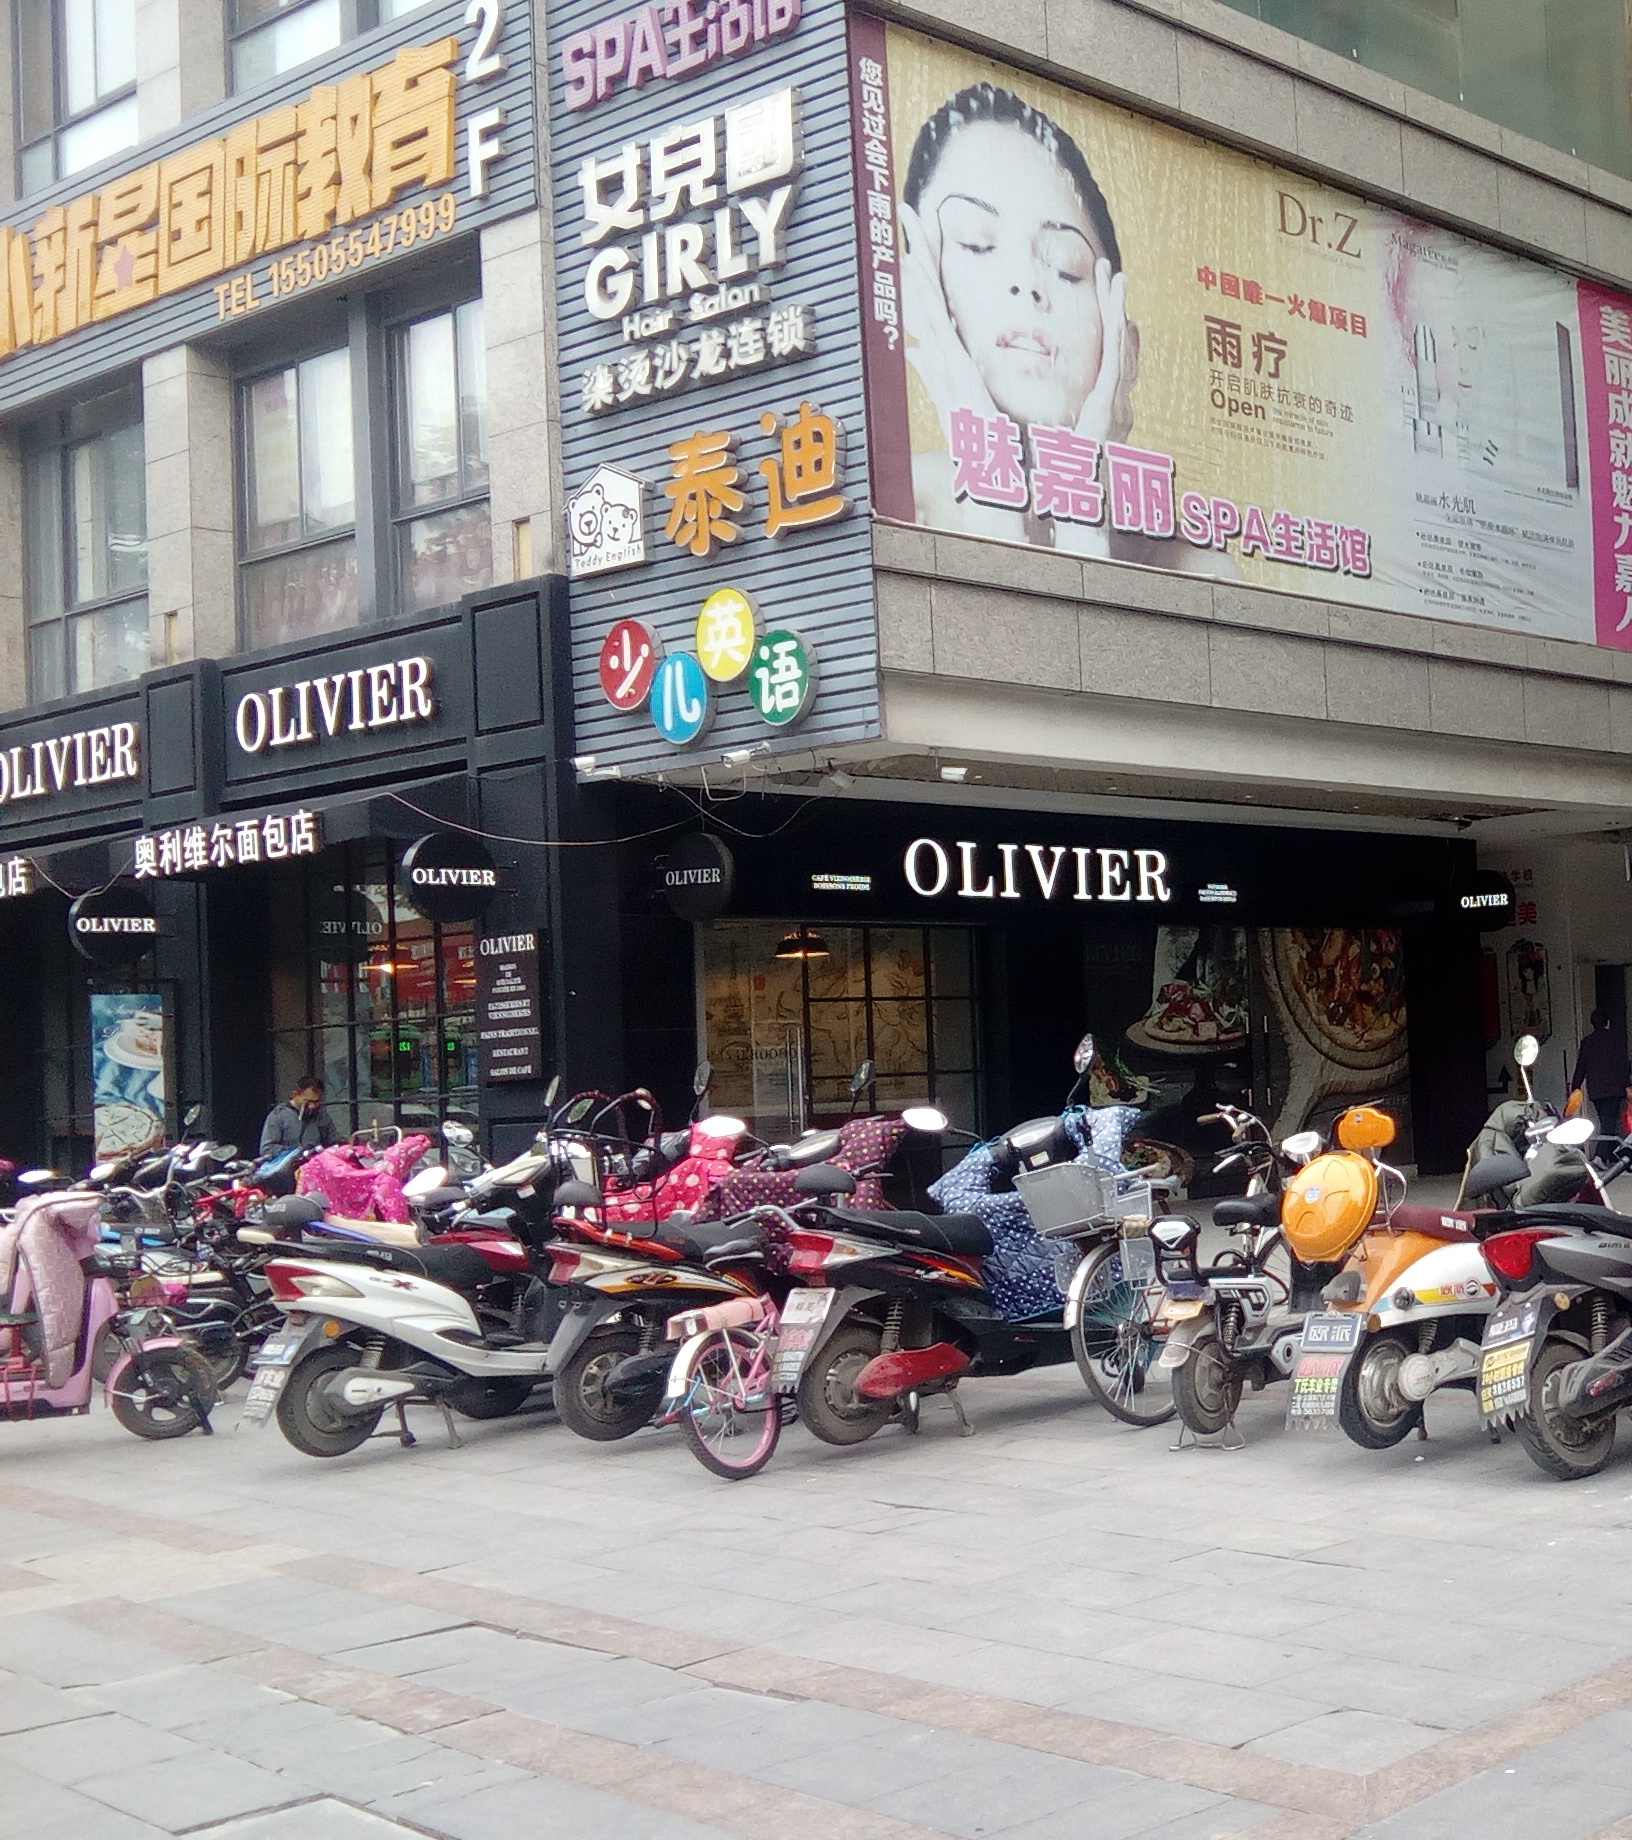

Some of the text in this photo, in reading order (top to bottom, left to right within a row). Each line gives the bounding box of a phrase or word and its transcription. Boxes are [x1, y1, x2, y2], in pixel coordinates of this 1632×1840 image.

[214, 192, 457, 321] TEL 15505547999
[585, 186, 792, 319] GIRLY
[1275, 190, 1363, 259] Dr.Z
[622, 284, 766, 342] Hair Salon
[1197, 265, 1368, 338] 中国唯一火爆项目
[581, 304, 812, 414] 染烫沙龙连锁
[1204, 315, 1288, 380] 雨疗
[1209, 368, 1354, 424] 开启肌肤抗衰的奇迹
[1210, 388, 1266, 421] Open
[664, 400, 849, 557] 泰迪
[948, 405, 1177, 541] 魅嘉丽
[1179, 492, 1372, 579] SPA生活馆
[575, 544, 643, 571] Teddy English
[607, 598, 804, 733] 少儿英语
[235, 656, 434, 755] OLIVIER
[134, 809, 322, 880] 奥利维尔面包店
[665, 866, 722, 887] OLIVIER
[905, 838, 1171, 902] OLIVIER
[411, 866, 496, 888] OLIVIER
[1460, 893, 1509, 909] OLIVIER
[76, 915, 156, 934] OLIVIER
[480, 932, 536, 957] OLIVIER
[1308, 1325, 1353, 1342] 欧派
